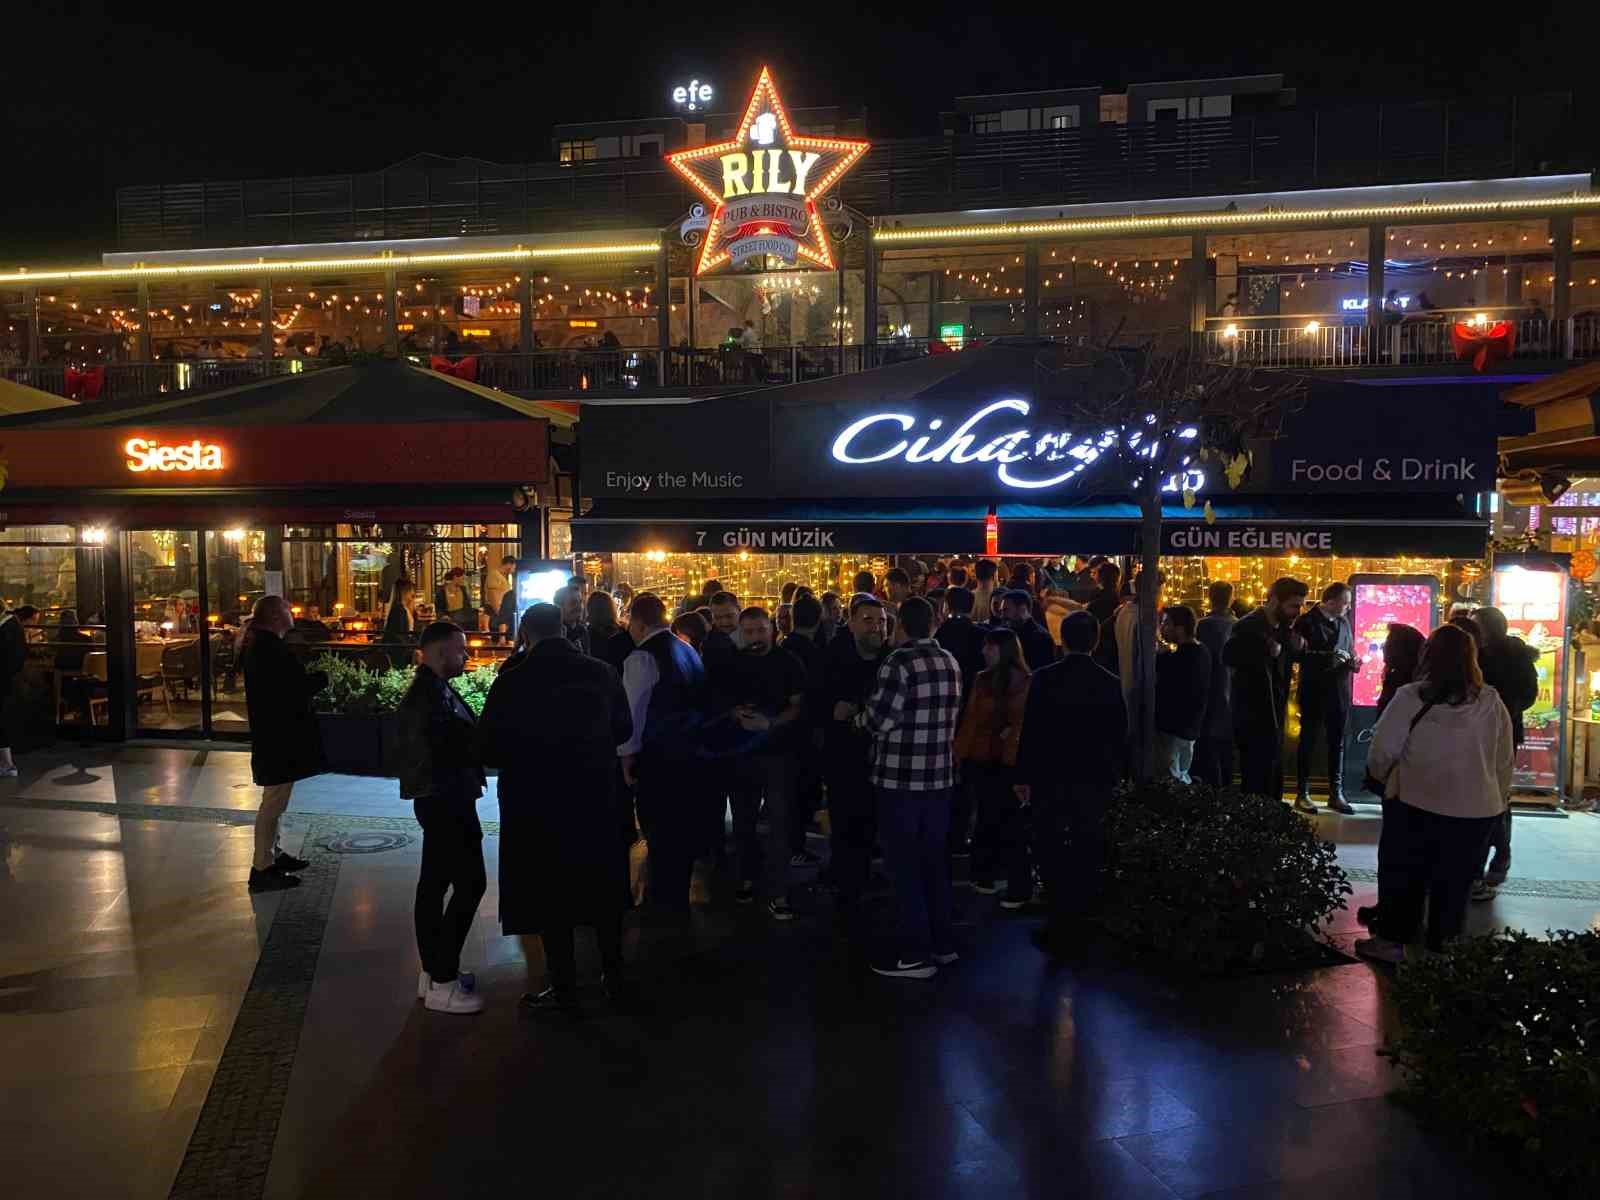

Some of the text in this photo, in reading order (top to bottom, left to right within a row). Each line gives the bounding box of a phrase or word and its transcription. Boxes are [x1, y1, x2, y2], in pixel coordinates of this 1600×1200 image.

[719, 149, 821, 199] RILY
[723, 206, 748, 225] PUB
[750, 204, 761, 217] &
[763, 203, 808, 223] BISTRO
[126, 438, 224, 471] Siesta
[1292, 457, 1475, 482] Food & Drink
[606, 471, 744, 492] Enjoy the Music
[696, 527, 835, 547] 7 GÜN MÜZİK
[1170, 527, 1333, 549] GÜN EĞLENCE
